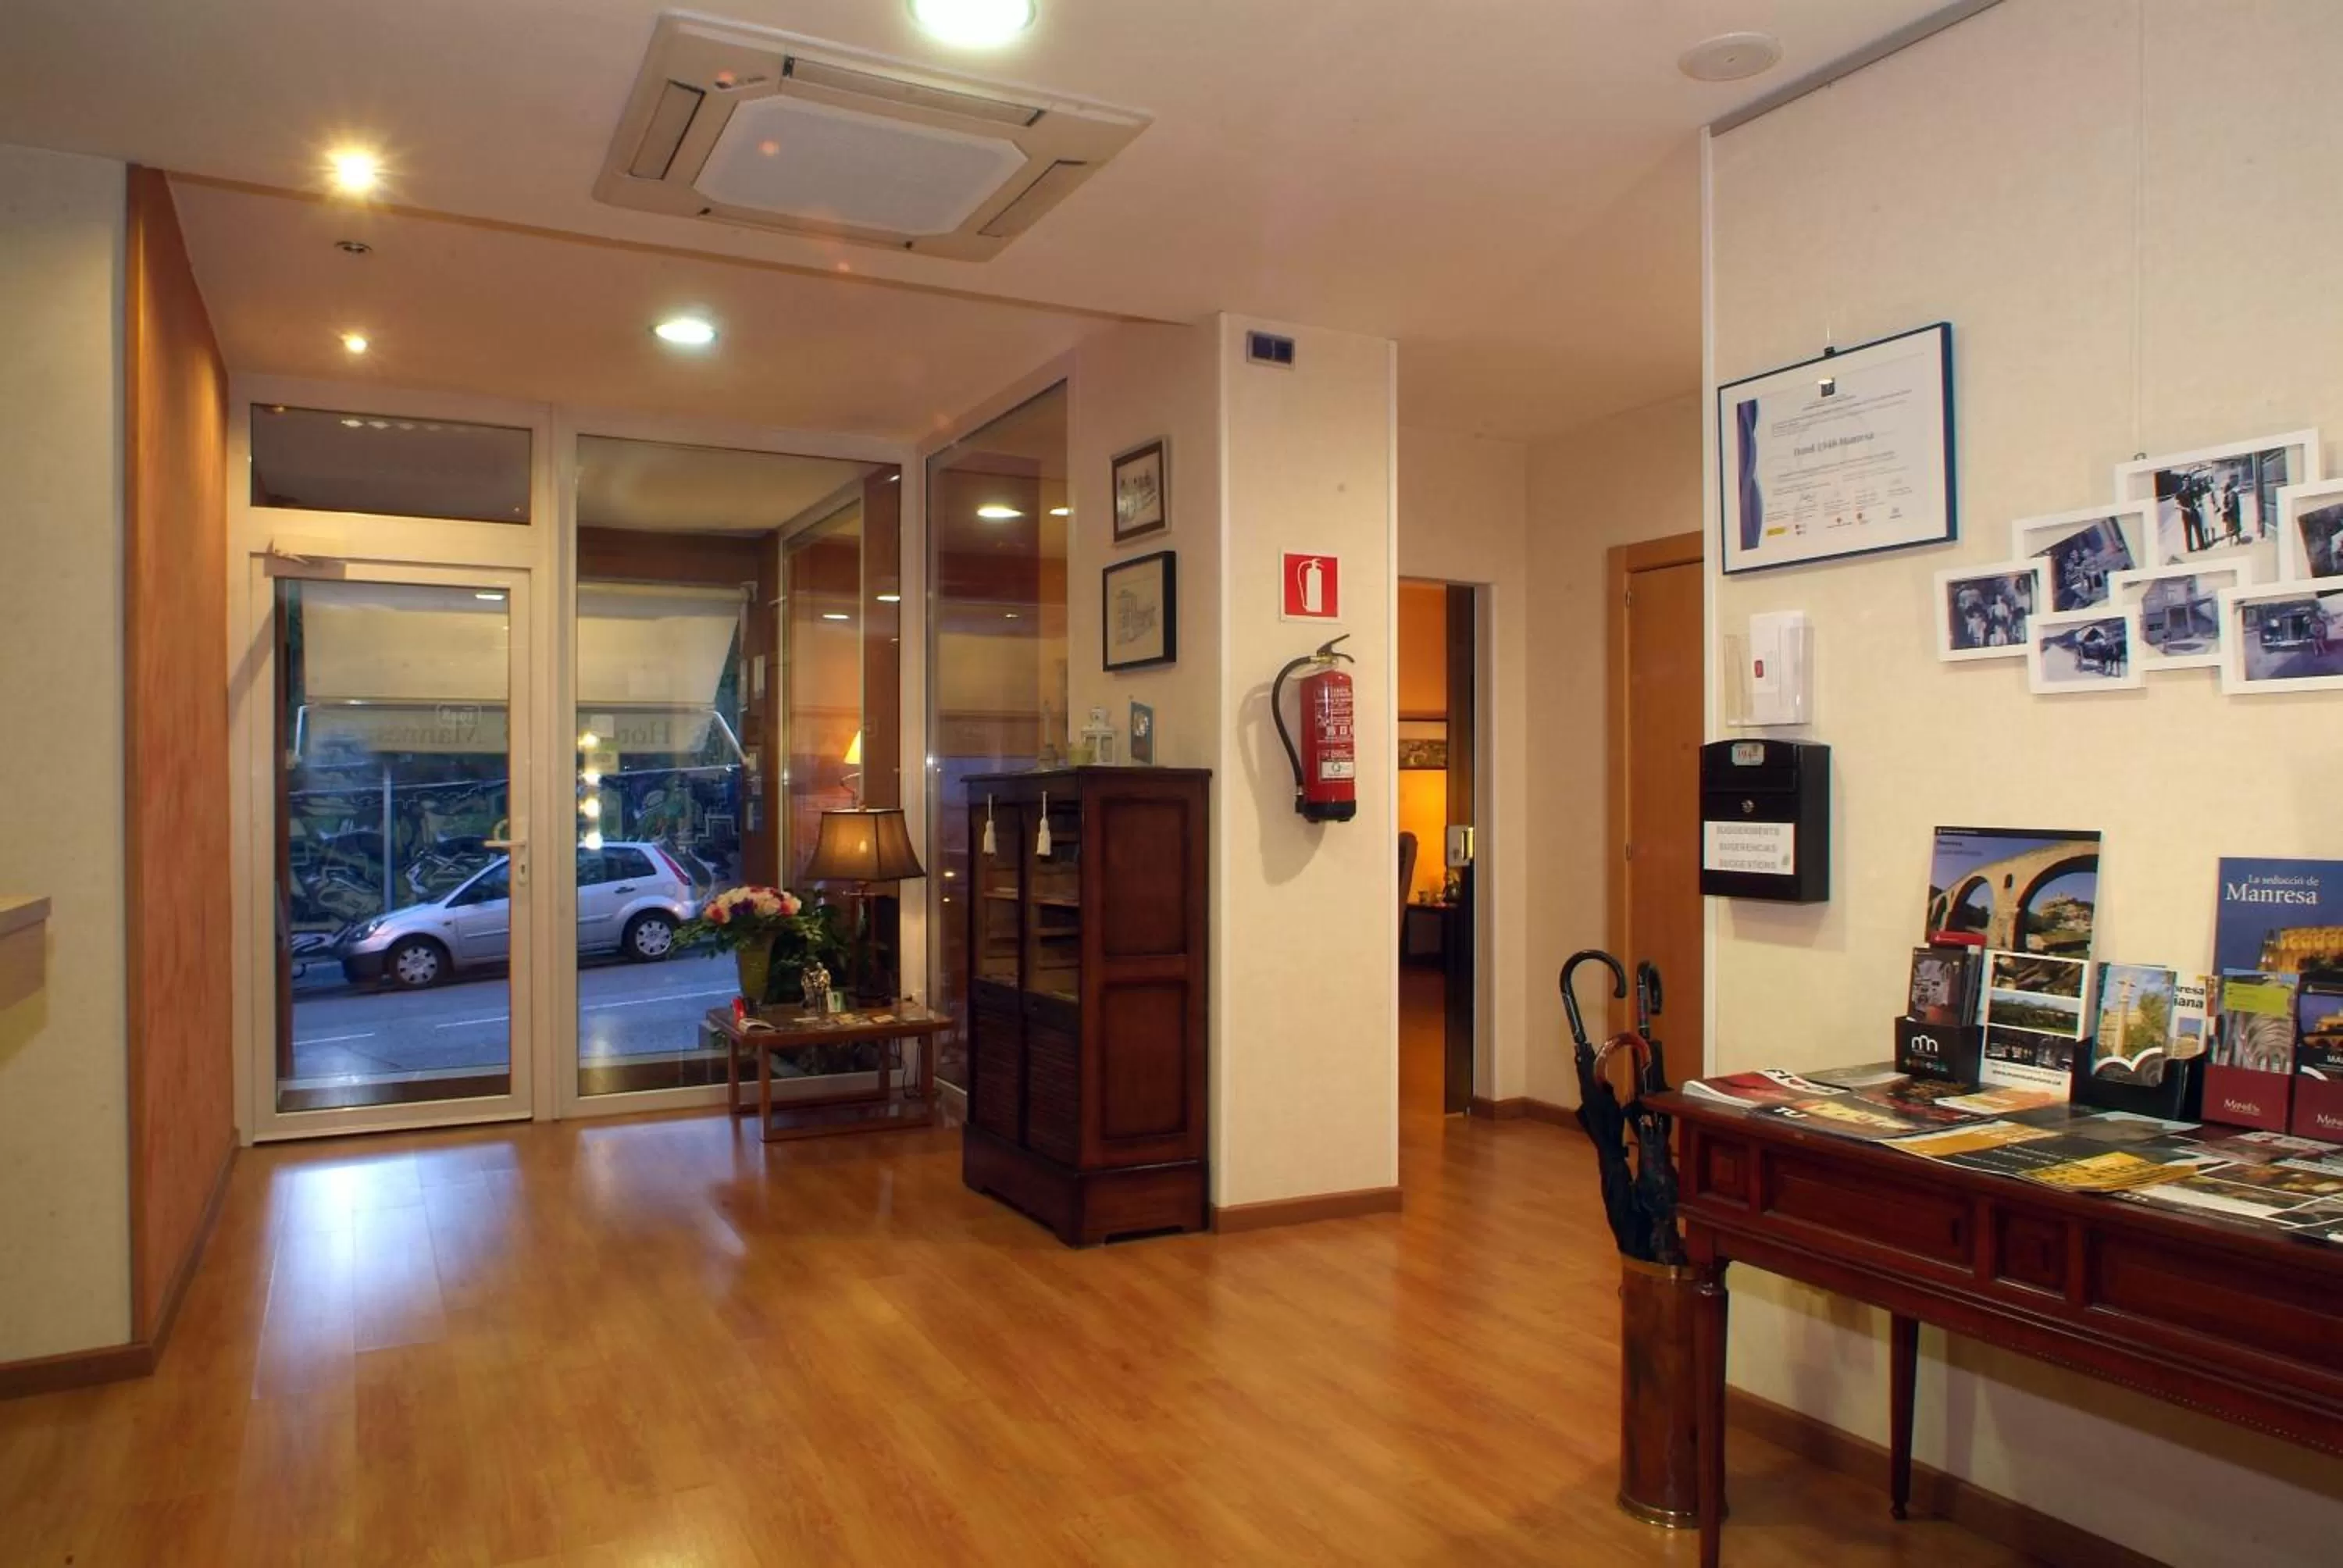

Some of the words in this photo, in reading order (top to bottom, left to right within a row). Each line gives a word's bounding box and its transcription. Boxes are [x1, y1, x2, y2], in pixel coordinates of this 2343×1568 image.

[2248, 874, 2260, 884] La
[2306, 875, 2320, 886] de
[2226, 882, 2318, 905] Manresa
